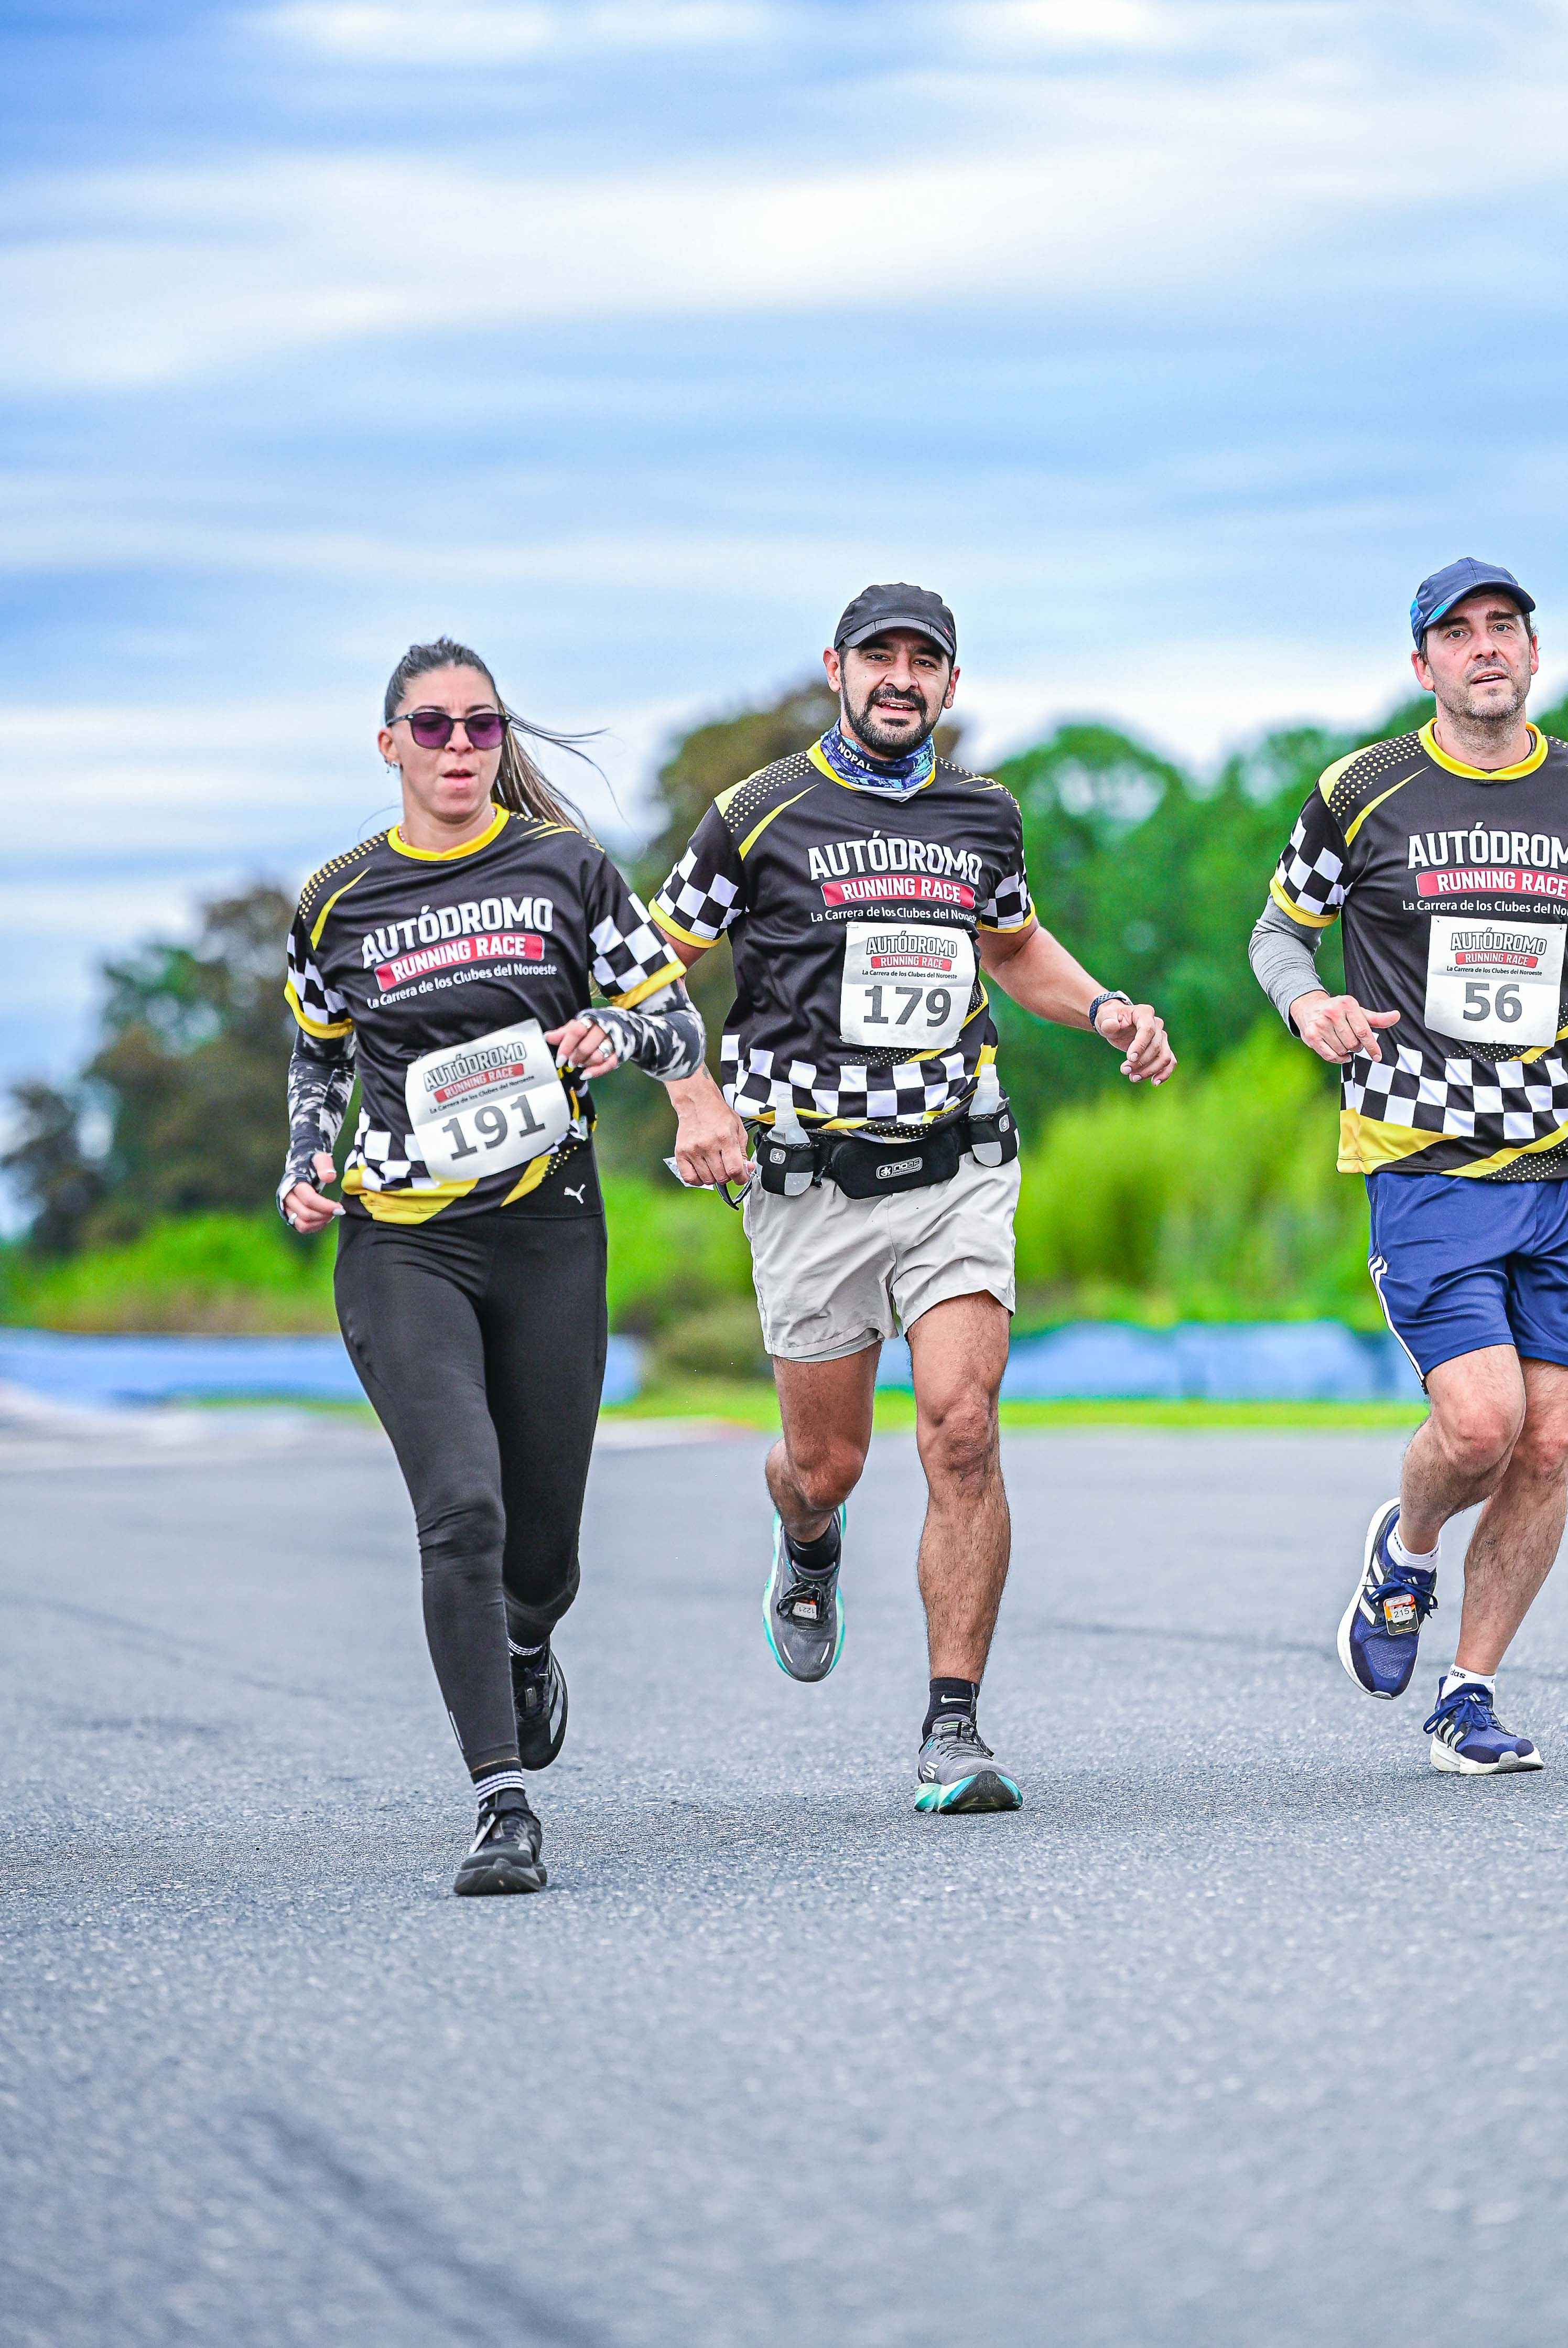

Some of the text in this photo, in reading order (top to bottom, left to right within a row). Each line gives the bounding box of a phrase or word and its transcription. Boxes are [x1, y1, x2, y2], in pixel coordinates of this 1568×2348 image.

[837, 741, 874, 772] NOPAL
[807, 830, 983, 885] AUTÓDROMO
[1407, 822, 1568, 869] AUTÓDROM
[840, 878, 961, 903] RUNNING RACE
[1436, 870, 1568, 898] RUNNING RACE
[810, 912, 823, 922] La
[825, 909, 863, 920] Carrera
[867, 906, 880, 917] de
[881, 907, 896, 917] los
[896, 907, 931, 918] Clubes
[933, 908, 949, 919] del
[1402, 900, 1415, 911] La
[1417, 900, 1457, 911] Carrera
[1460, 900, 1474, 911] de
[1476, 900, 1492, 911] los
[1494, 901, 1531, 913] Clubes
[1533, 903, 1550, 914] del
[361, 897, 554, 969] AUTÓDROMO
[866, 931, 957, 958] AUTÓDROMO
[1451, 928, 1547, 955] AUTÓDROMO
[390, 936, 526, 982] RUNNING RACE
[880, 956, 944, 970] RUNNING RACE
[1465, 952, 1529, 966] RUNNING RACE
[367, 963, 557, 1009] La Carrera de los Clubes del Noroeste
[863, 985, 951, 1027] 179
[1463, 982, 1522, 1023] 56
[423, 1041, 527, 1092] AUTÓDROMO
[443, 1068, 514, 1100] RUNNING RACE
[442, 1094, 546, 1161] 191
[1393, 1608, 1410, 1619] 215
